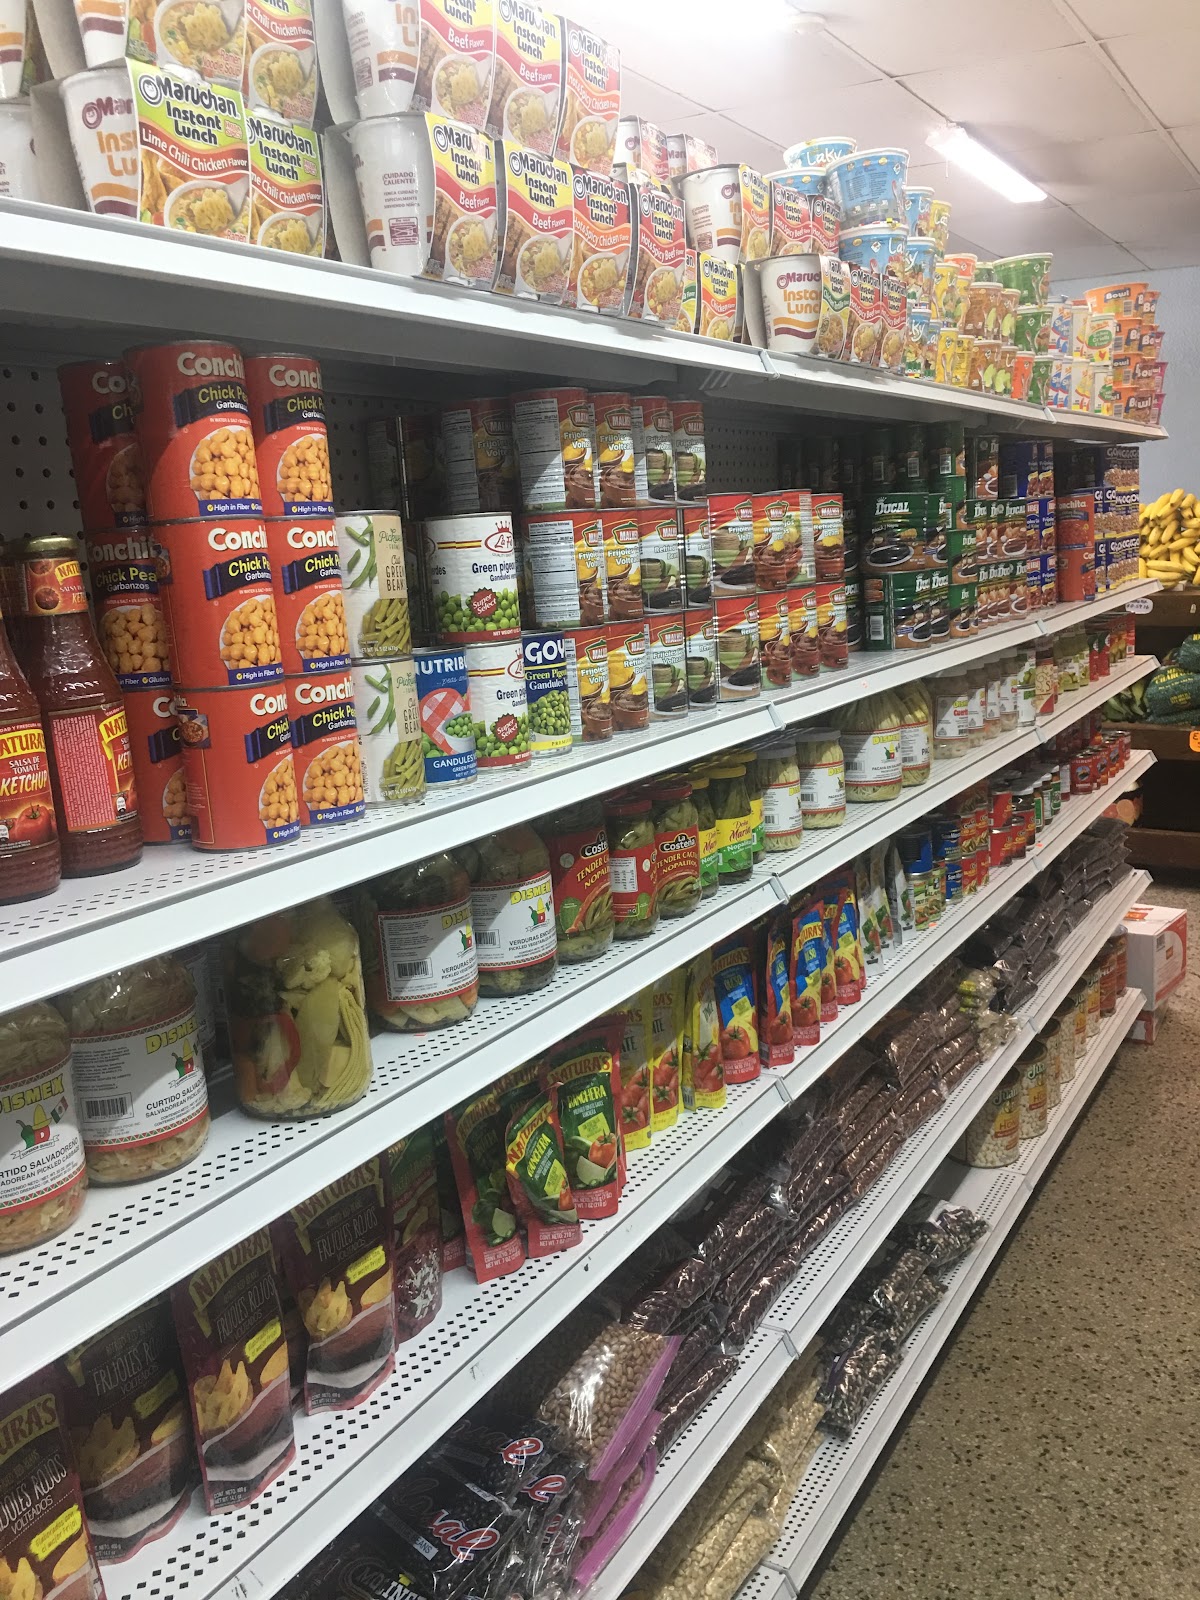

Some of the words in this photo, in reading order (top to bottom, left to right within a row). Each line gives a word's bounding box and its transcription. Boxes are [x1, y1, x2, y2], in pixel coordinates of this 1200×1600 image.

[444, 2, 473, 25] Lunch
[269, 19, 298, 38] Chicken
[514, 18, 545, 47] Instant
[448, 28, 469, 49] Beef
[517, 37, 543, 60] Lunch
[520, 64, 538, 80] Beef
[582, 52, 609, 79] Instant
[585, 68, 606, 90] Lunch
[157, 74, 239, 118] Maruchan
[166, 101, 222, 131] Instant
[174, 120, 218, 145] Lunch
[250, 118, 314, 156] Maruchan
[142, 129, 167, 151] Lime
[167, 145, 190, 167] Chili
[191, 156, 228, 172] Chicken
[259, 144, 302, 168] Instant
[265, 158, 299, 181] Lunch
[451, 152, 482, 173] Instant
[520, 152, 569, 185] Maruchan
[456, 164, 480, 186] Lunch
[525, 173, 557, 195] Instant
[262, 179, 279, 200] Chili
[279, 188, 306, 203] Chicken
[530, 188, 555, 207] Lunch
[583, 174, 628, 206] Maruchan
[460, 191, 477, 209] Beef
[587, 196, 617, 215] Instant
[649, 193, 684, 222] Maruchan
[533, 212, 551, 229] Beef
[590, 208, 614, 226] Lunch
[651, 213, 676, 231] Instant
[599, 235, 619, 246] Chicken
[654, 226, 673, 242] Lunch
[664, 248, 676, 261] Beef
[708, 260, 735, 280] Maruchan
[710, 275, 729, 291] Instant
[713, 285, 727, 297] Lunch
[1106, 289, 1130, 300] Bowl
[199, 385, 235, 403] Chick
[287, 398, 318, 413] Chick
[214, 503, 230, 513] High
[236, 502, 250, 511] Fiber
[298, 505, 311, 514] High
[317, 505, 327, 513] Fiber
[875, 501, 909, 515] DUCAL
[228, 557, 261, 577] Chick
[304, 556, 335, 573] Chick
[472, 563, 497, 574] Green
[96, 566, 127, 588] Chick
[490, 573, 511, 583] Gandules
[107, 581, 150, 592] Garbanzos
[473, 594, 493, 610] Super
[476, 599, 498, 616] Select
[316, 661, 330, 669] High
[335, 659, 345, 668] Fiber
[148, 676, 170, 684] Gluten
[243, 672, 257, 680] High
[263, 670, 275, 678] Fiber
[525, 669, 549, 682] Green
[529, 678, 563, 691] Gandules
[496, 688, 518, 702] Green
[312, 710, 345, 727] Chick
[496, 719, 514, 735] Super
[501, 724, 518, 742] Select
[9, 759, 27, 769] SALSA
[31, 756, 40, 765] DE
[13, 765, 40, 774] TOMATE
[433, 754, 474, 769] GANDULES
[1, 770, 47, 796] KETCHUP
[324, 812, 338, 820] High
[344, 809, 354, 817] Fiber
[278, 829, 290, 838] High
[735, 819, 748, 830] Doña
[663, 837, 696, 852] Costeña
[678, 834, 686, 843] La
[657, 853, 682, 868] TENDER
[576, 858, 602, 882] TENDER
[509, 935, 538, 946] VERDURAS
[509, 944, 528, 952] PICKLED
[442, 961, 468, 974] VERDURAS
[442, 971, 459, 980] PICKLED
[147, 1094, 180, 1110] CURTIDO
[568, 1084, 607, 1109] RANCHERA
[146, 1098, 187, 1118] SALVADOREAN
[29, 1138, 78, 1170] SALVADOREÑO
[527, 1133, 551, 1177] RANCHERA
[36, 1159, 62, 1176] PICKLED
[316, 1220, 352, 1262] FRIJOLES
[354, 1206, 378, 1239] ROJOS
[216, 1293, 247, 1343] FRIJOLES
[249, 1273, 274, 1307] ROJOS
[94, 1354, 141, 1397] FRIJOLES
[31, 1453, 67, 1500] ROJOS
[11, 1494, 53, 1535] VOLTEADOS
